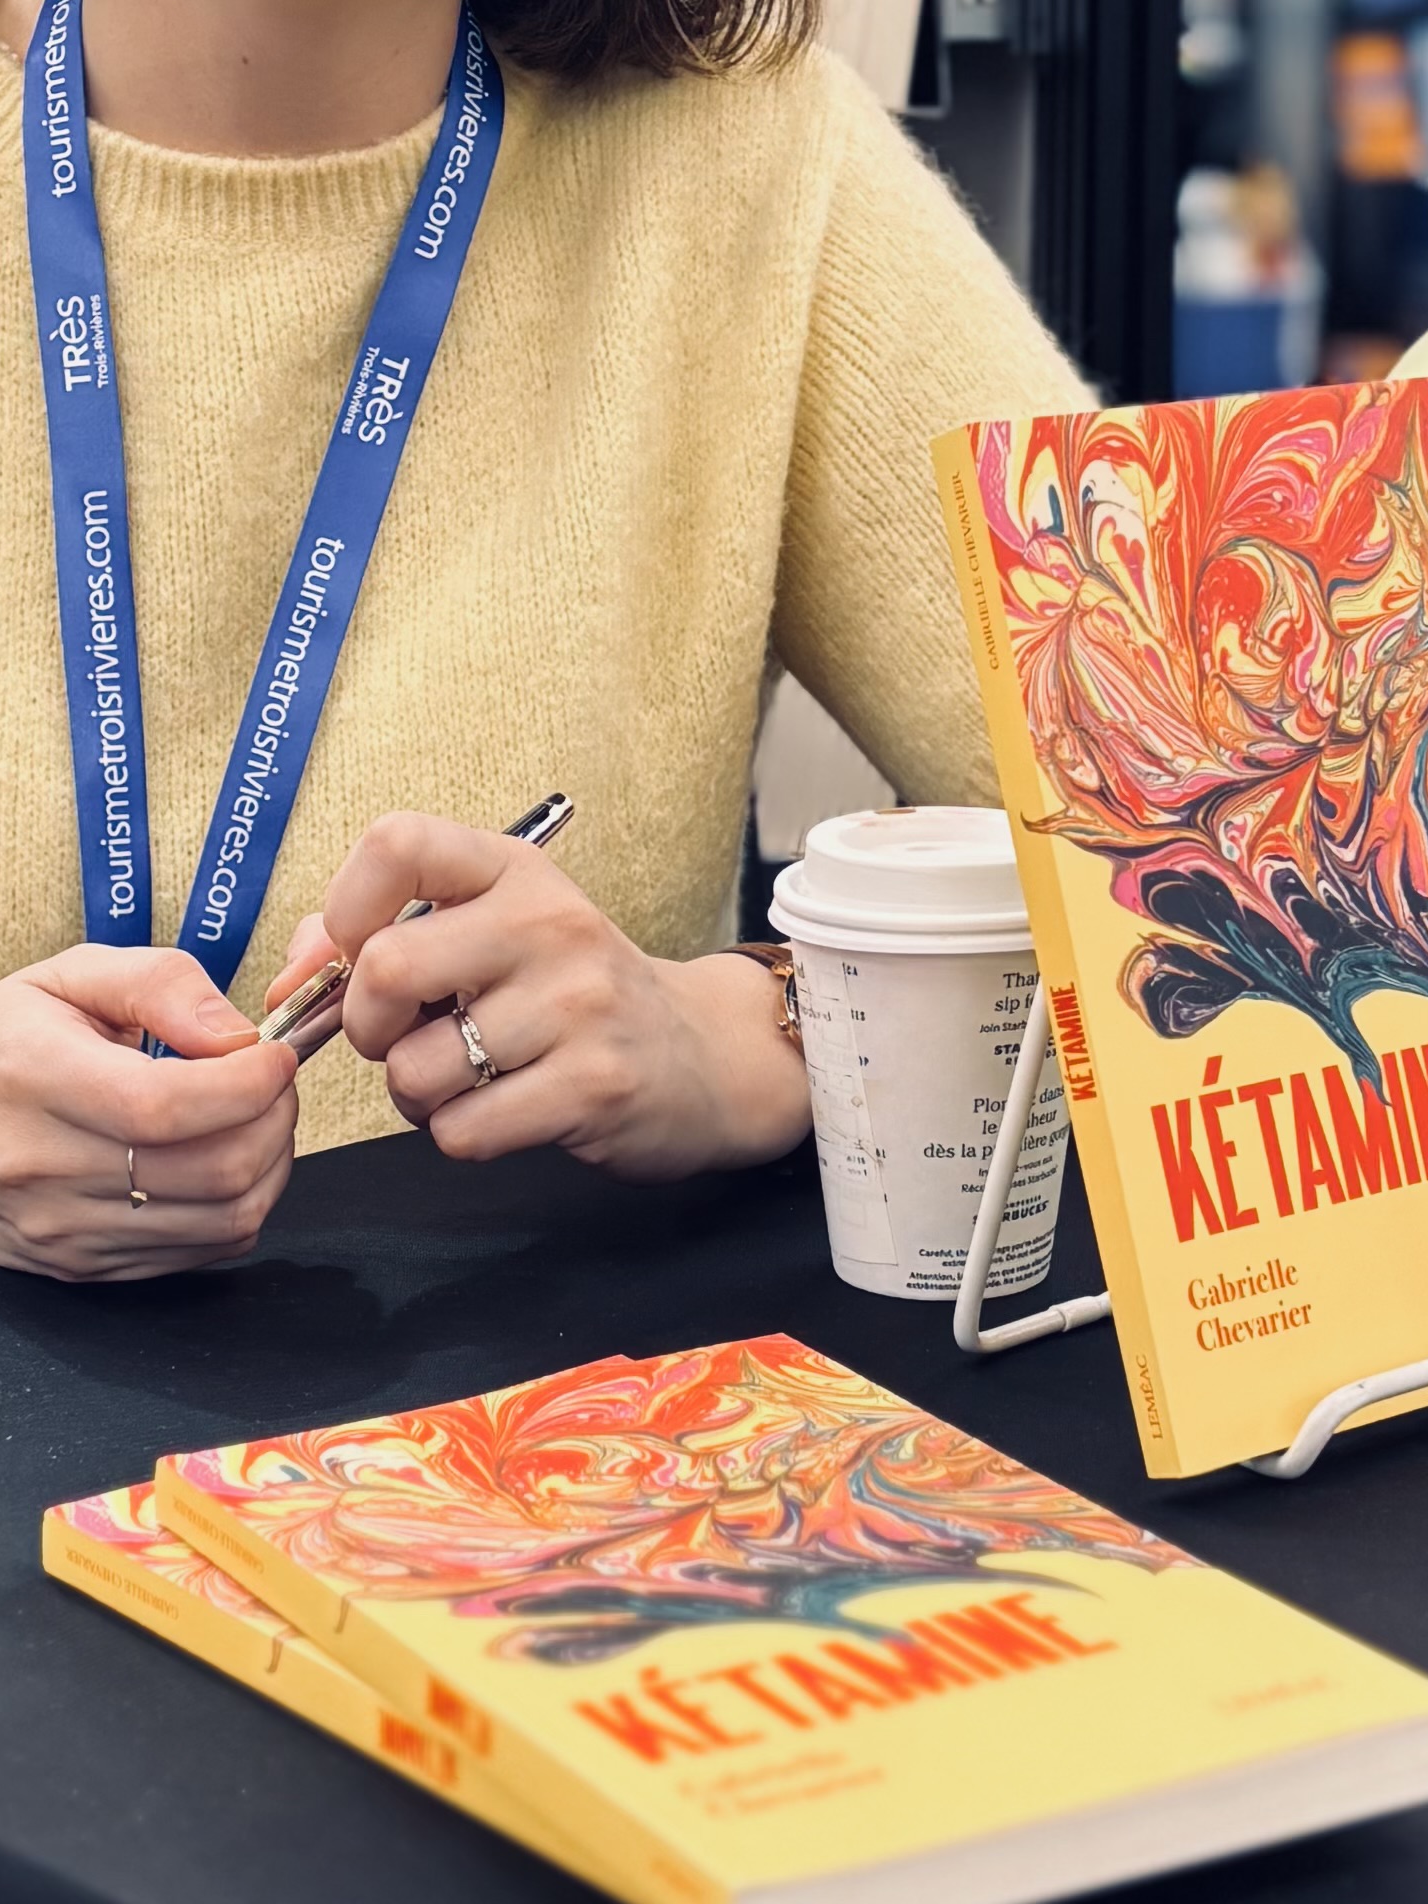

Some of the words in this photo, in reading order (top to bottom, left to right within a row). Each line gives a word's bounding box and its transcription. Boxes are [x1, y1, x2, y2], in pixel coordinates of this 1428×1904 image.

[89, 294, 109, 389] Trois-Rivières
[341, 346, 381, 435] Trois-Rivières
[951, 470, 980, 572] CHEVARIER
[973, 575, 1000, 671] GABRIELLE
[83, 489, 136, 920] tourismetroisrivieres.com
[198, 536, 345, 943] tourismetroisrivieres.com
[1050, 981, 1097, 1101] KÉTAMINE
[923, 1143, 956, 1159] dès
[960, 1143, 977, 1159] la
[1186, 1258, 1299, 1311] Gabrielle
[1195, 1300, 1312, 1352] Chevarier
[1135, 1353, 1164, 1440] LEMÉAC
[571, 1590, 1122, 1765] KÉTAMINE
